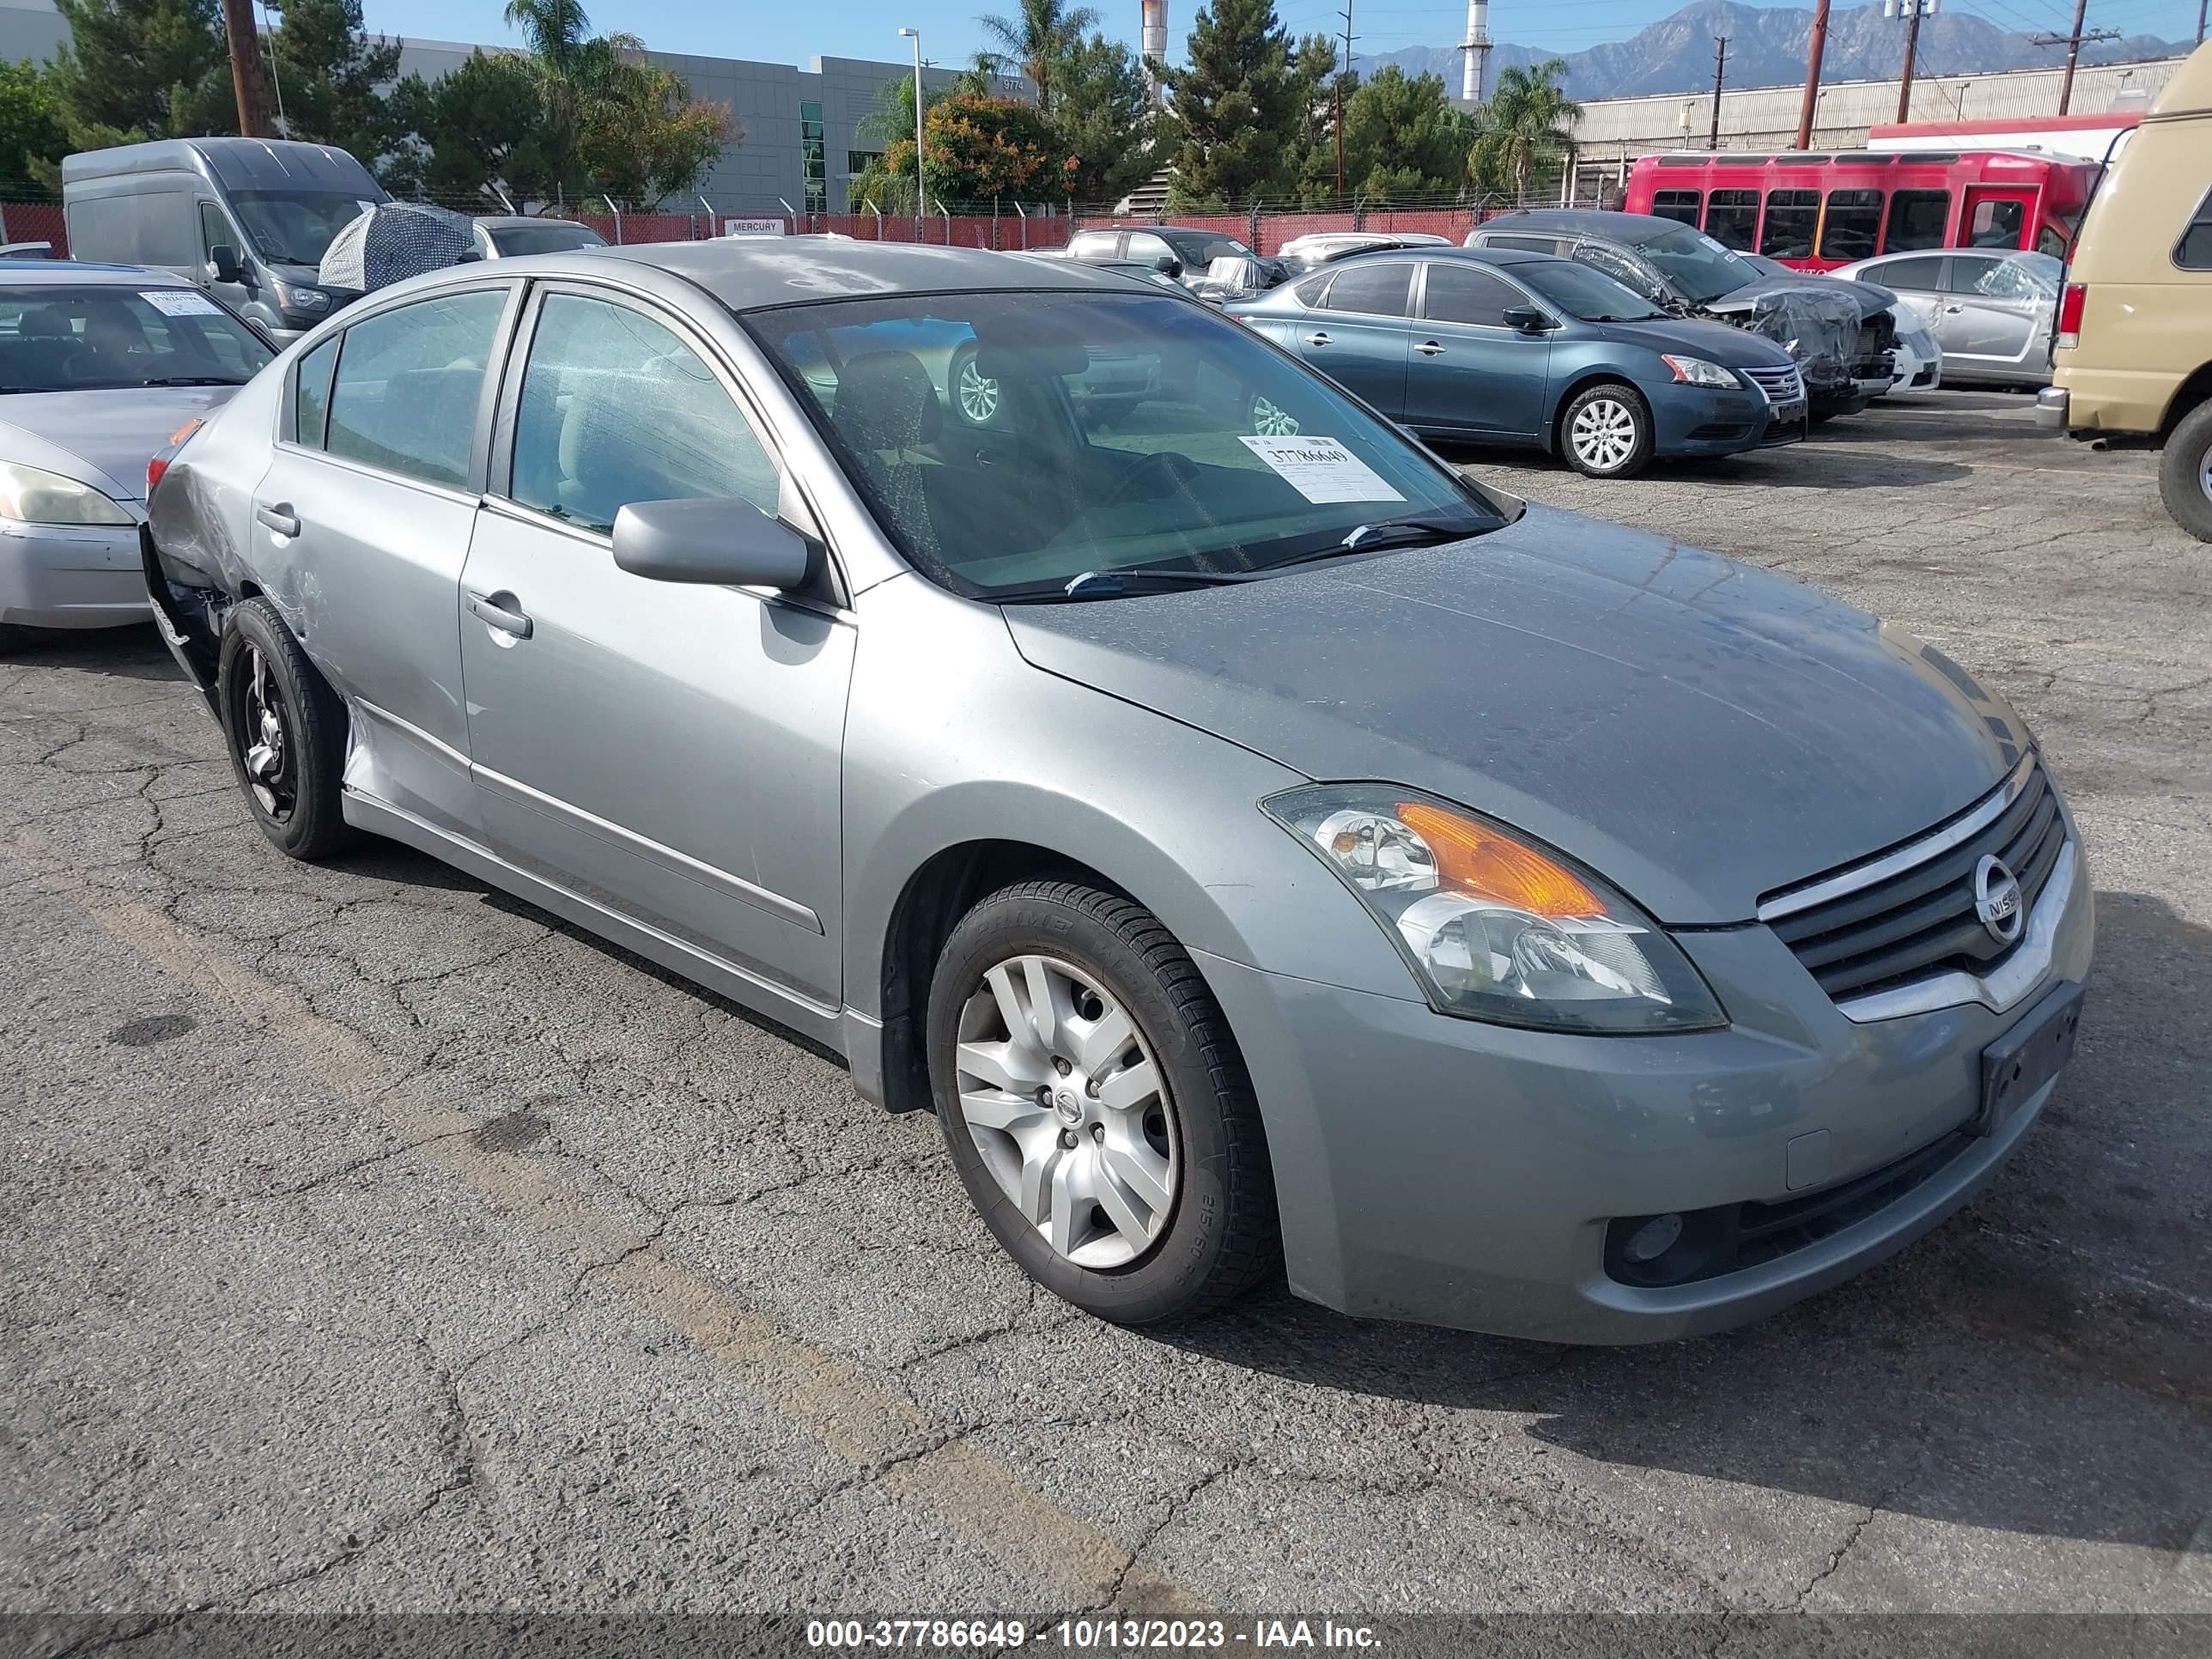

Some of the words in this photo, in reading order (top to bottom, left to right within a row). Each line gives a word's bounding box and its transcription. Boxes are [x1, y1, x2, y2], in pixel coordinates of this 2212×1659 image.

[1004, 79, 1024, 90] 9774
[733, 222, 776, 231] MERCURY
[1267, 449, 1349, 463] 37786649
